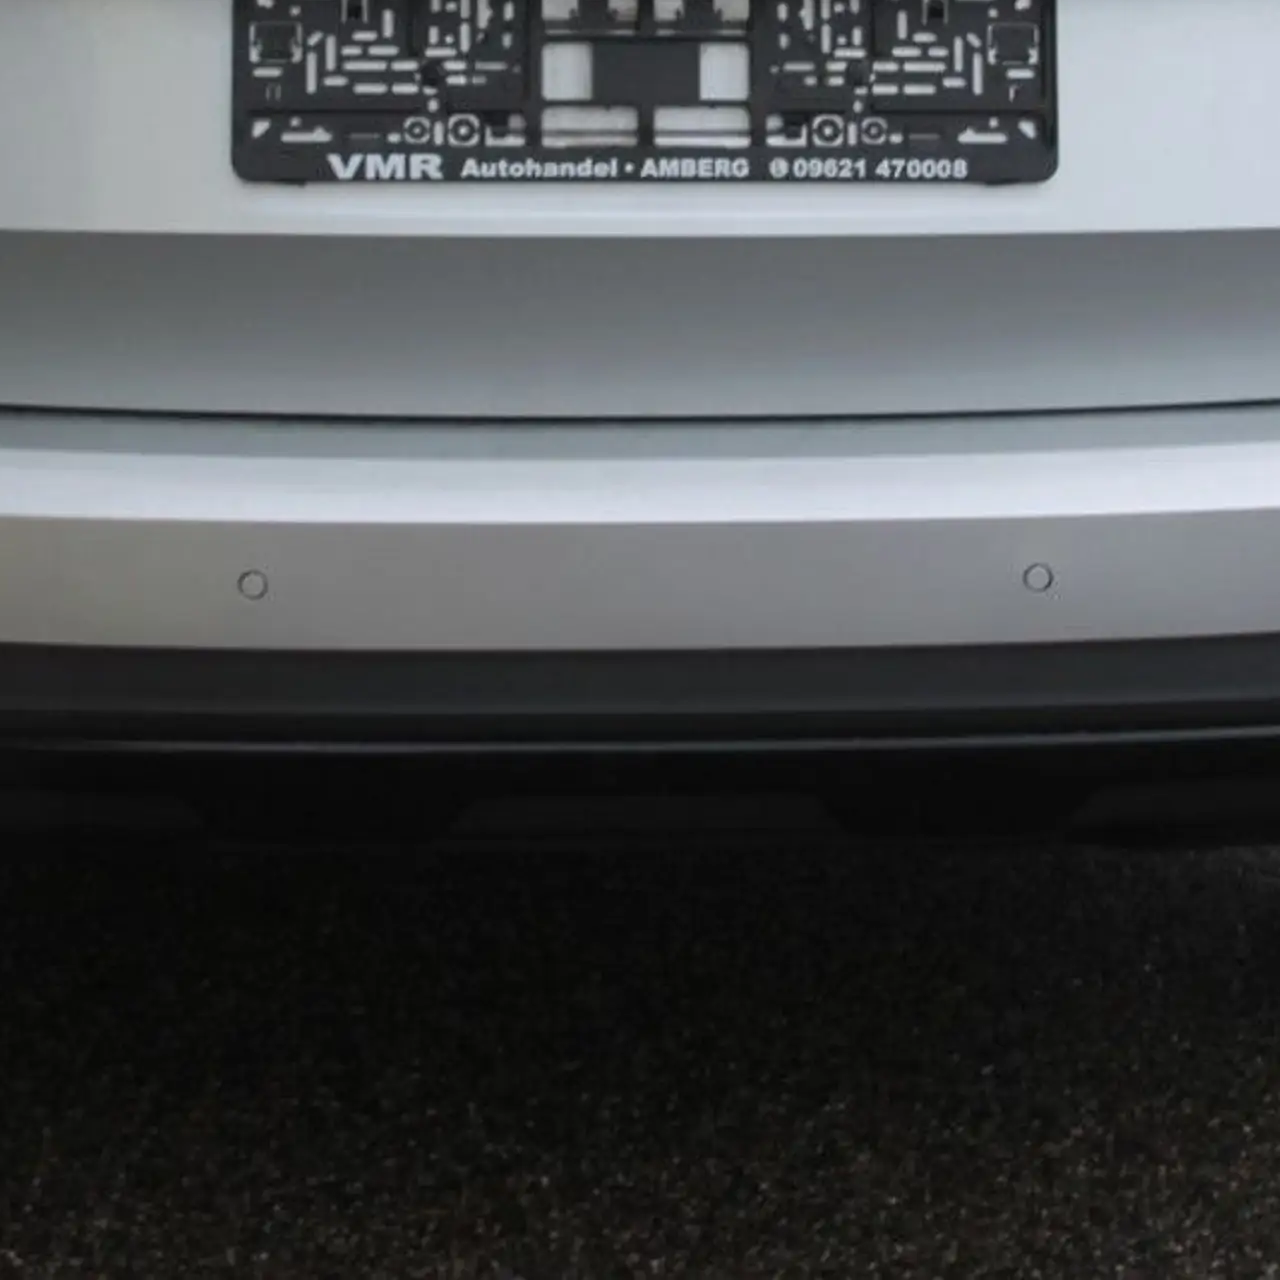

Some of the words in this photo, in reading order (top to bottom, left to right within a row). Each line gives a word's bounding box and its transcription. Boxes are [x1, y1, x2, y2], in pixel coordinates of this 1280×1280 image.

[326, 153, 445, 180] VMR
[460, 157, 618, 179] Autohandel
[640, 157, 750, 179] AMBERG
[793, 157, 868, 179] 09621
[875, 157, 969, 179] 470008
